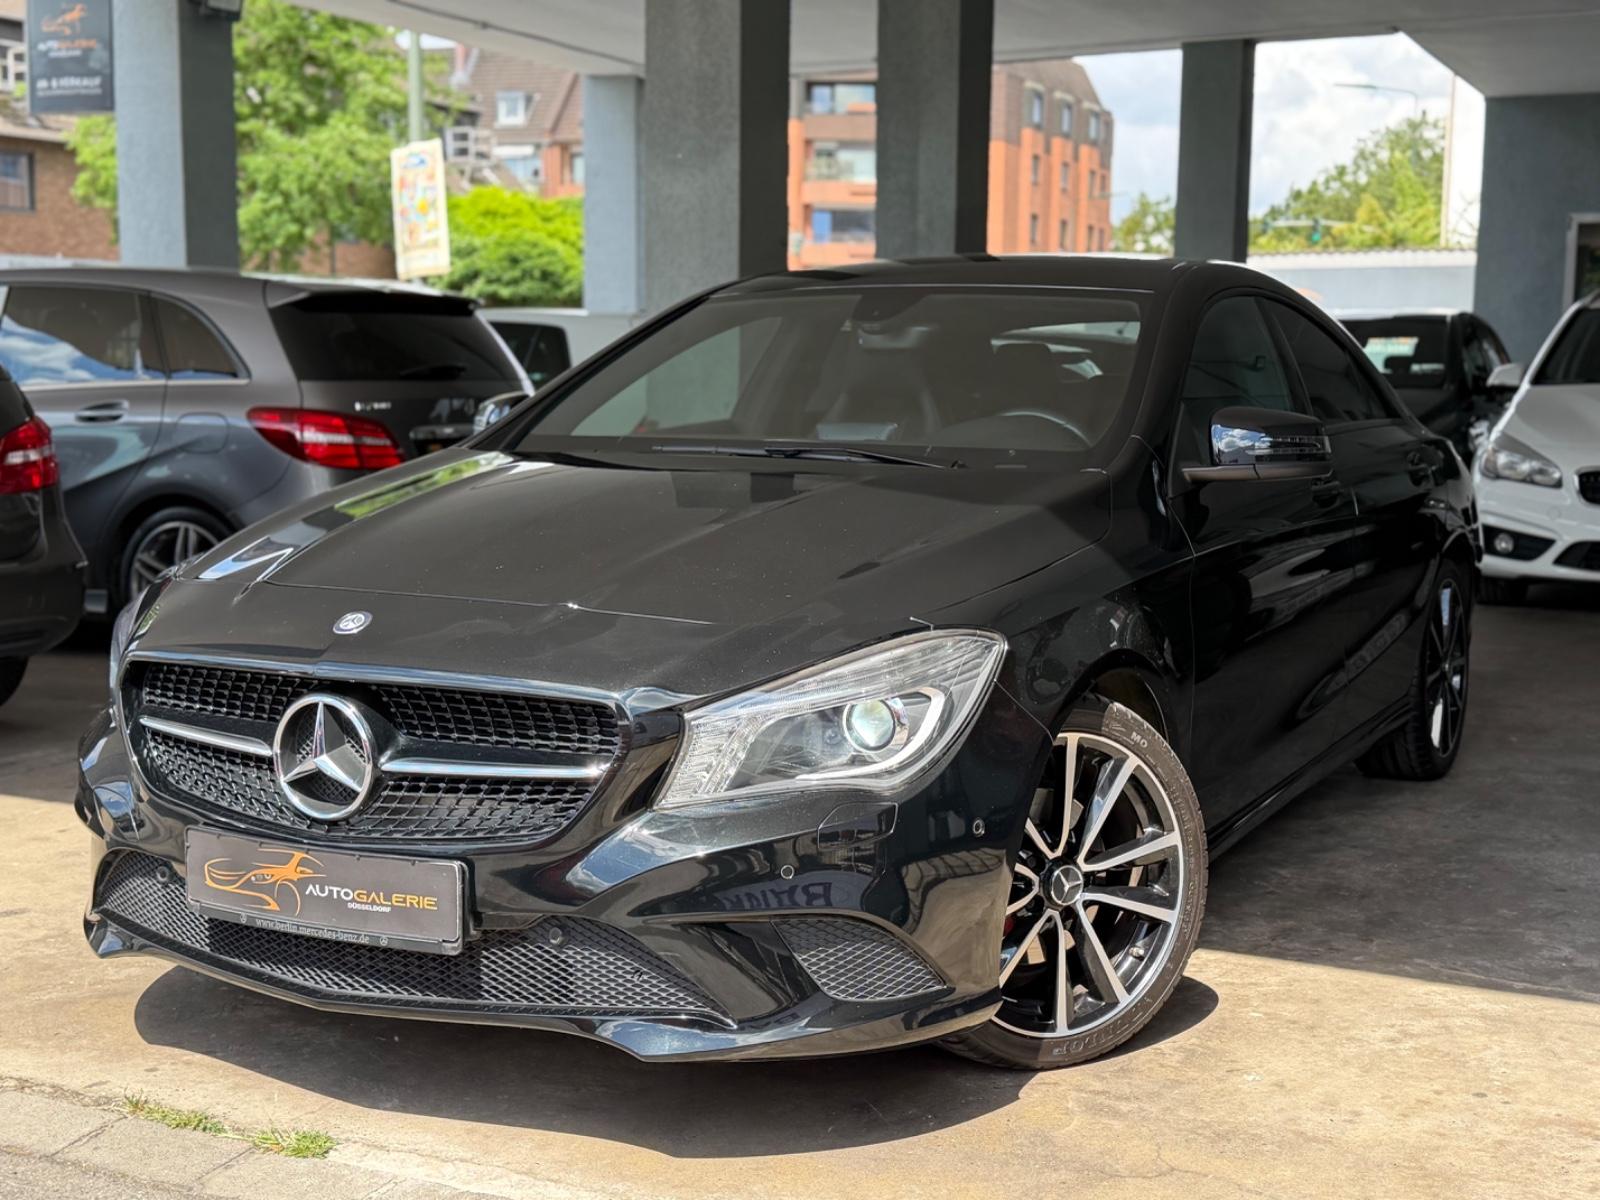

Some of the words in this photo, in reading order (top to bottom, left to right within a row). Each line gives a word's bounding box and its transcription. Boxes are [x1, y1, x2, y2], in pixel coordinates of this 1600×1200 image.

[305, 883, 438, 911] AUTOGALERIE
[347, 902, 392, 913] DÜSSELDORF
[255, 918, 370, 944] www.berlin.mercedes-benz.de
